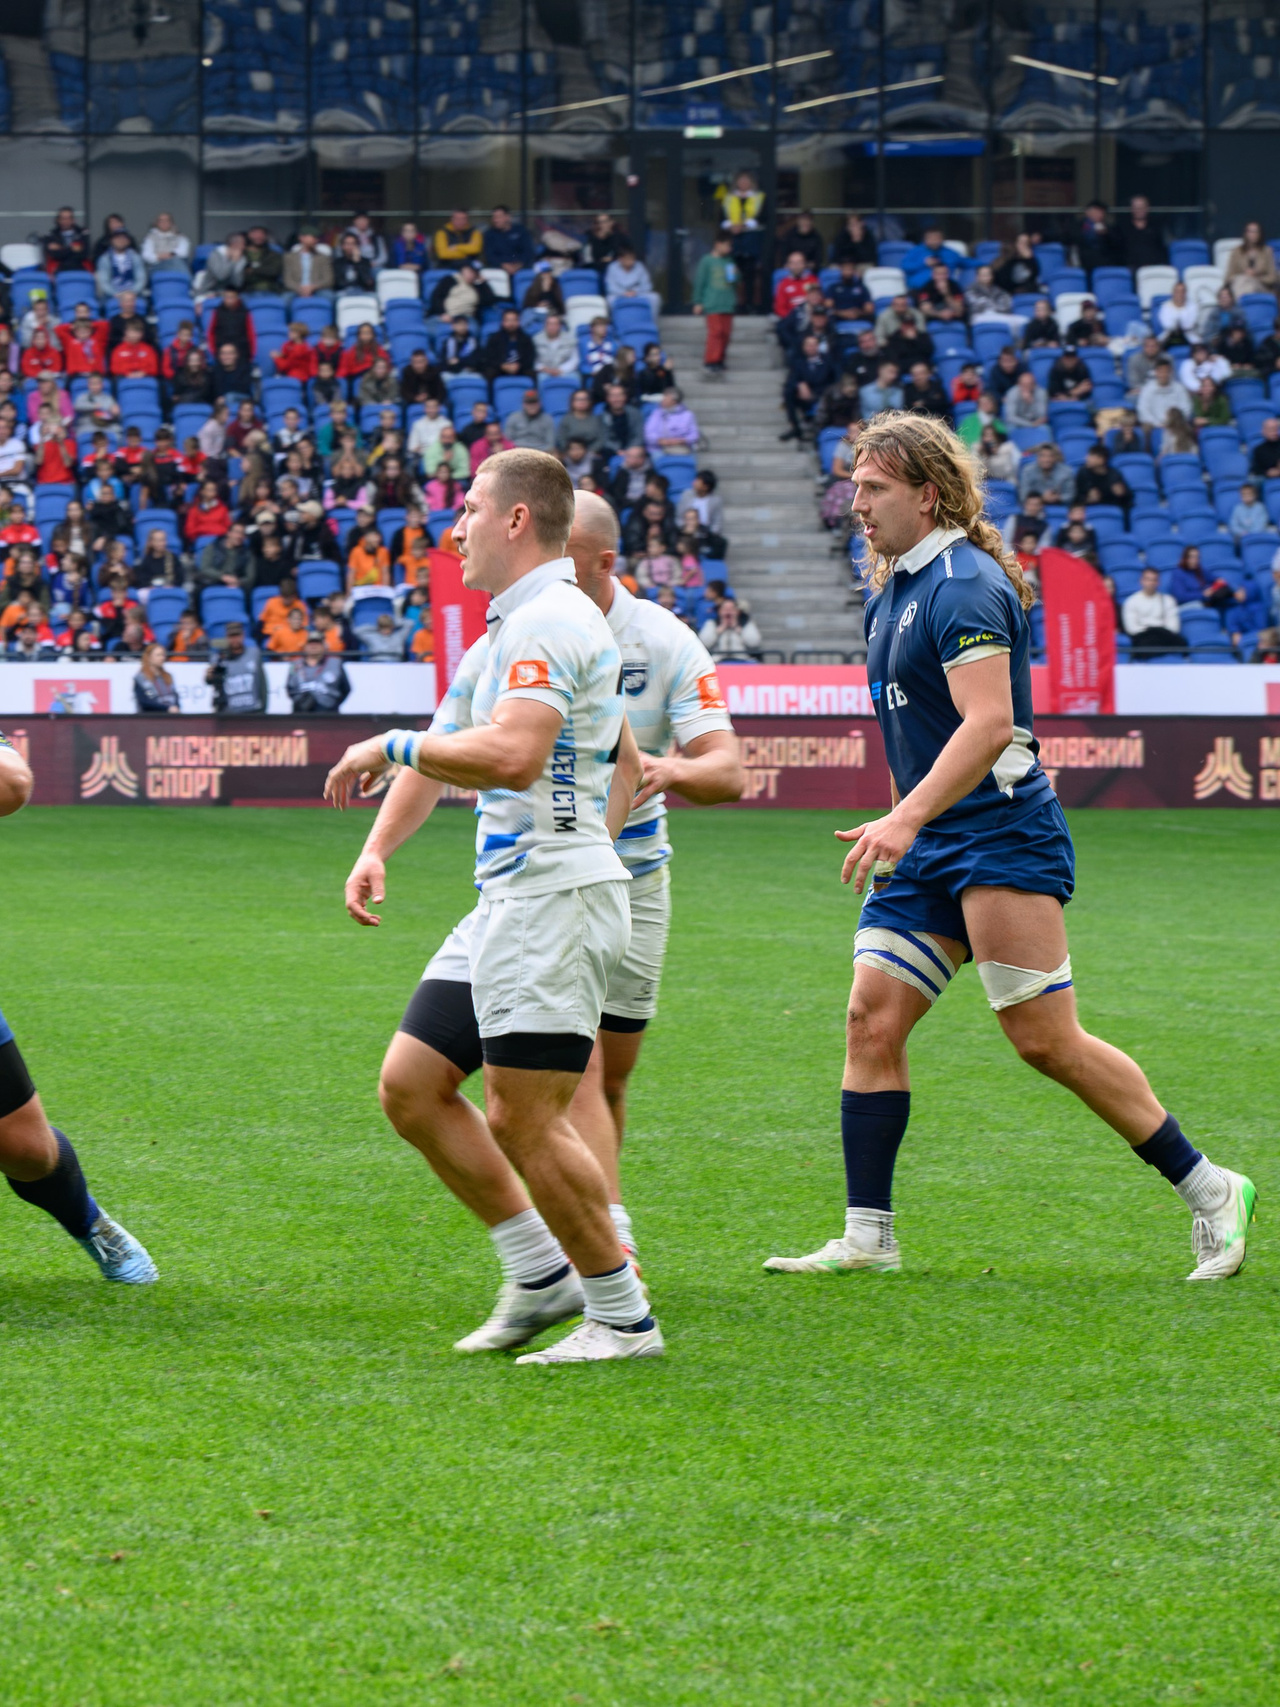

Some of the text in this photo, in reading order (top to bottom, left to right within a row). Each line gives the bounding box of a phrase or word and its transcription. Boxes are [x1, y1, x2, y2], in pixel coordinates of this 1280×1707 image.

[146, 729, 308, 767] МОСКОВСКИЙ
[741, 729, 866, 769] СКОВСКИЙ
[1040, 730, 1145, 768] КОВСКИЙ
[146, 768, 224, 799] СПОРТ
